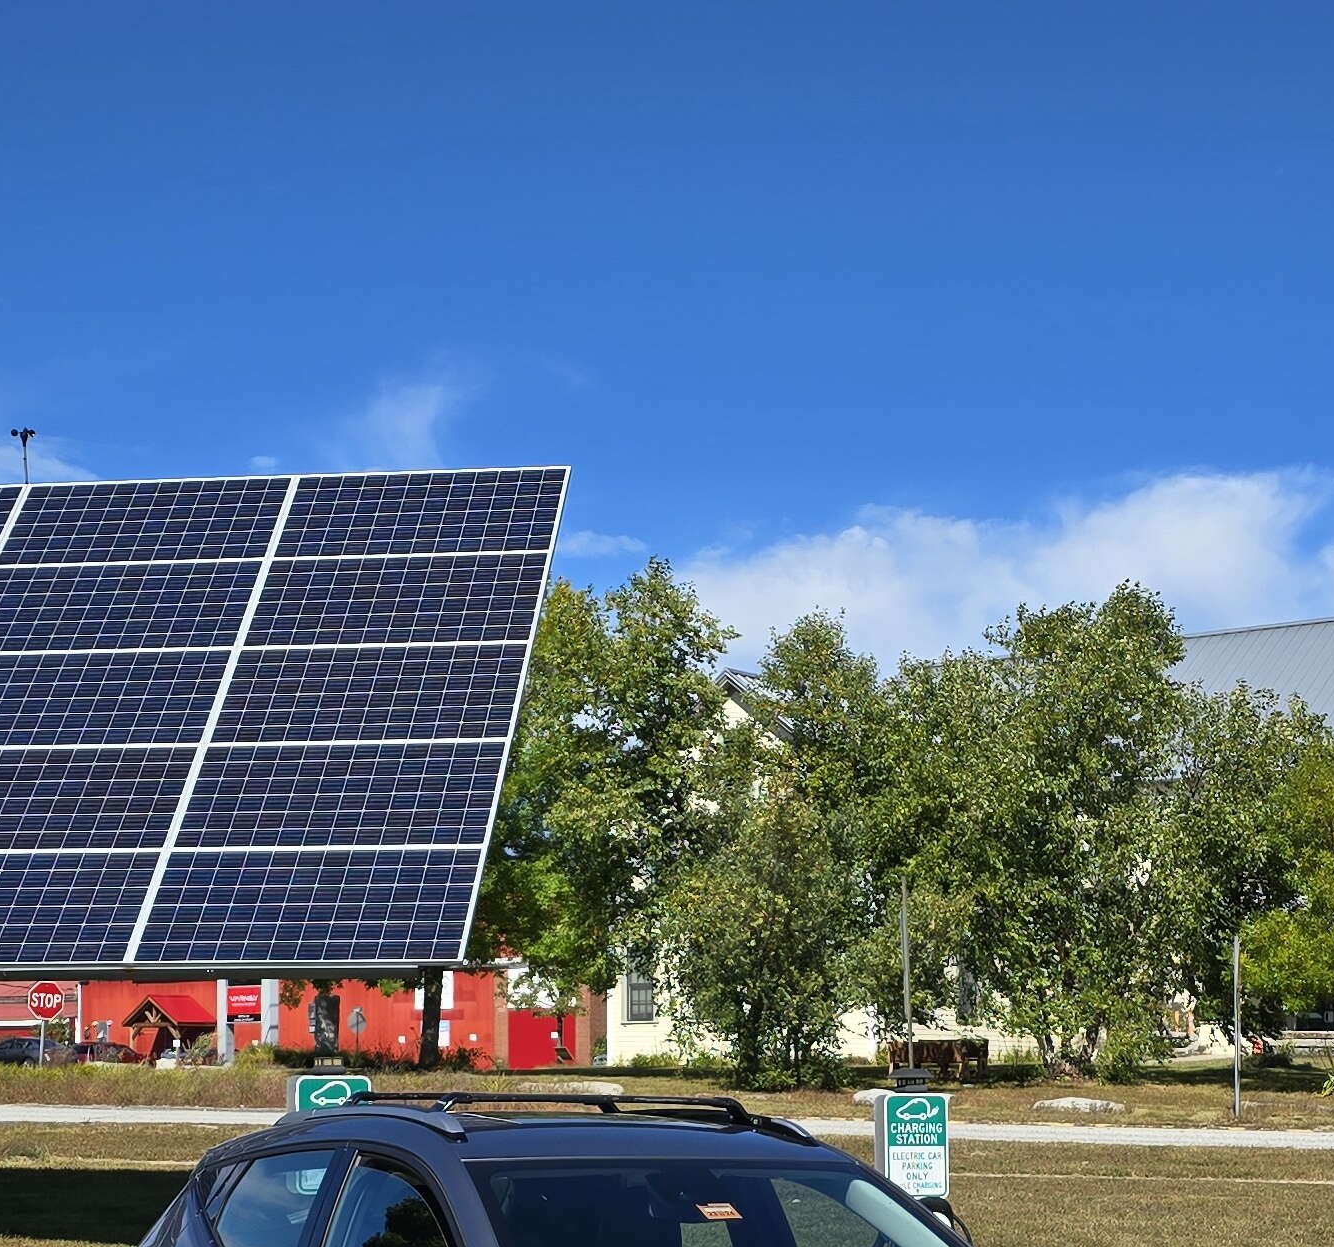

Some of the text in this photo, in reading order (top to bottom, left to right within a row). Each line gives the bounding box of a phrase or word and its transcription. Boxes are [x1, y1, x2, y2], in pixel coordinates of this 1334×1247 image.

[31, 993, 62, 1008] STOP
[891, 1123, 942, 1133] CHARGING
[896, 1134, 938, 1144] STATION
[892, 1151, 942, 1160] ELECTRIC CAR
[902, 1161, 933, 1170] PARKING
[906, 1172, 928, 1180] ONLY
